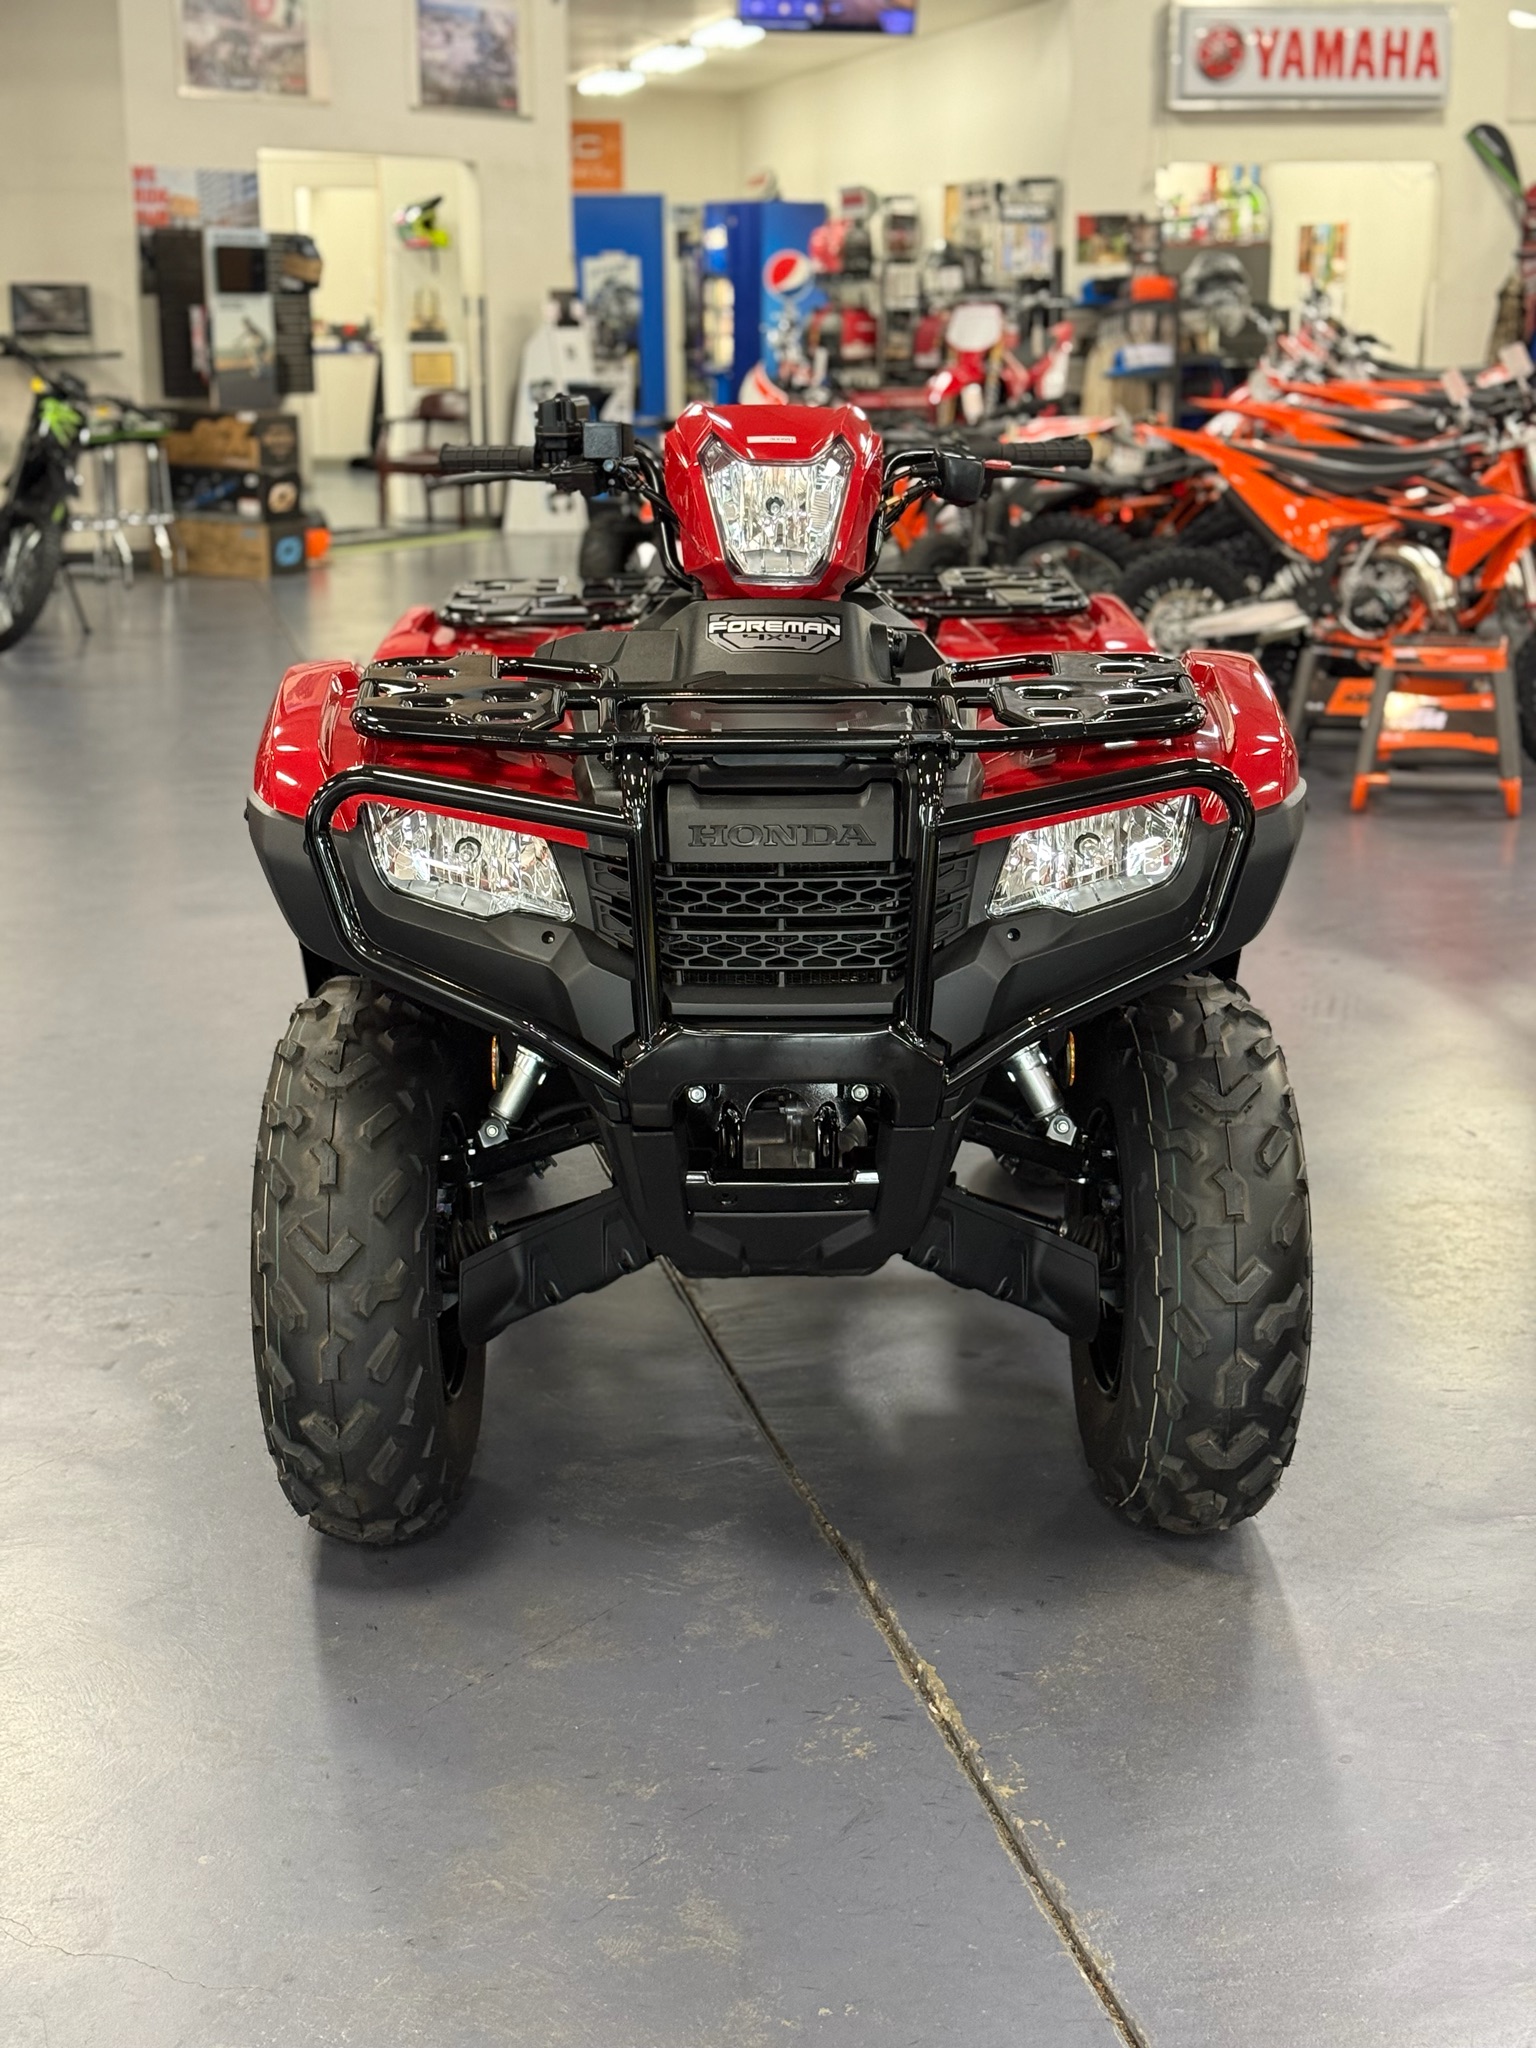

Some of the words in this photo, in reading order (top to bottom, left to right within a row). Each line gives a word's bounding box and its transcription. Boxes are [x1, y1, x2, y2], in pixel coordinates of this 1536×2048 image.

[1254, 27, 1440, 80] YAMAHA
[708, 620, 841, 636] FOREMAN
[688, 824, 877, 847] HONDA
